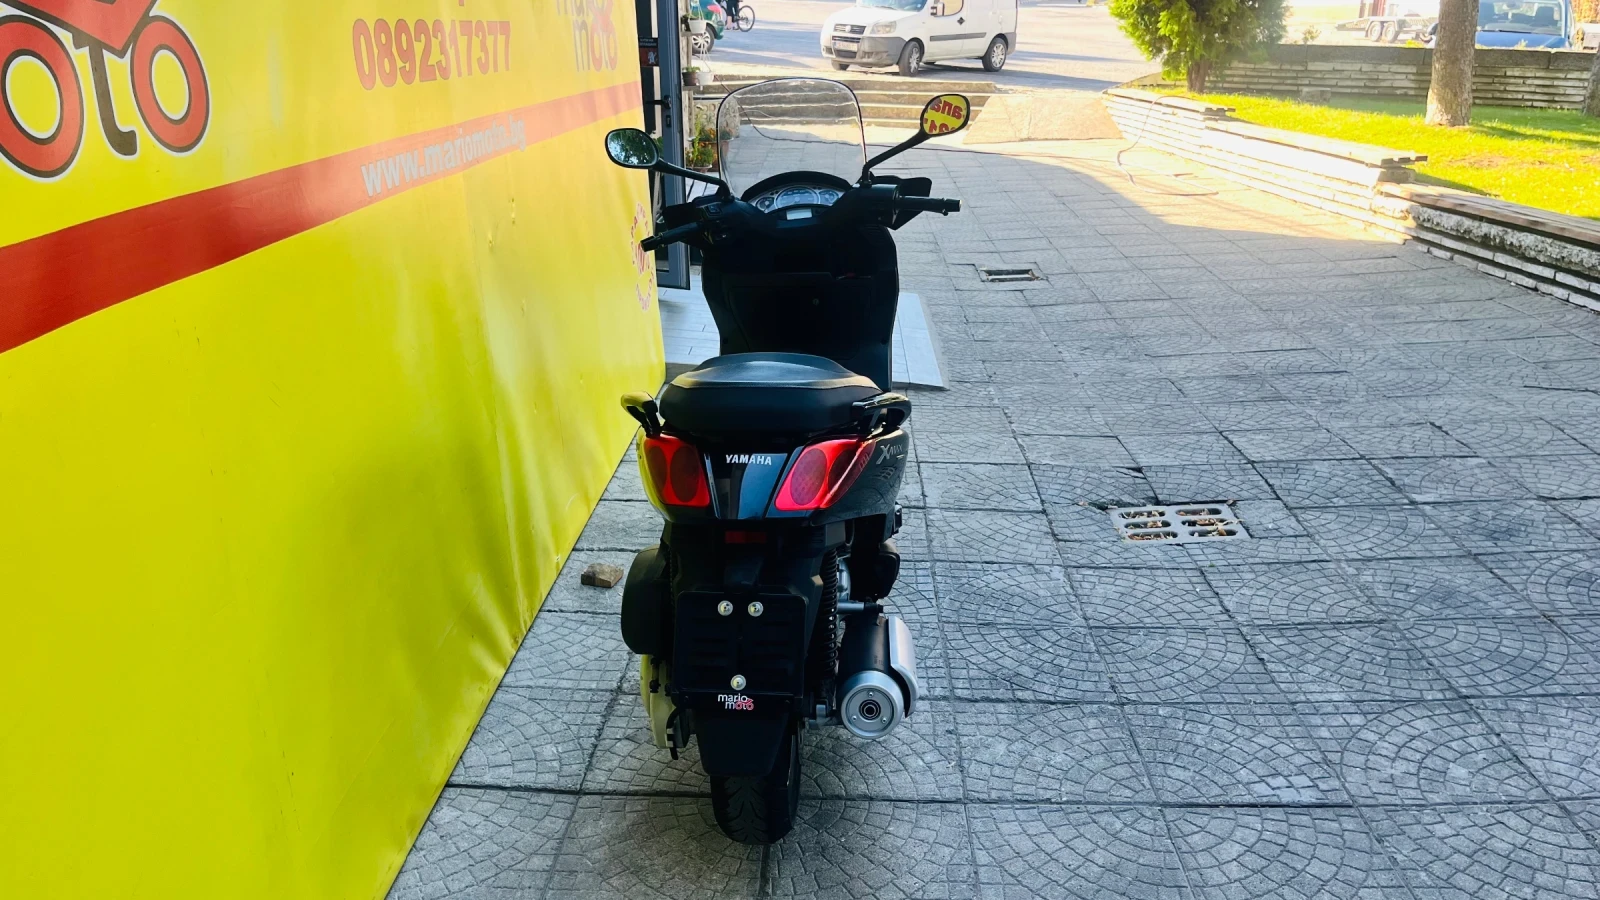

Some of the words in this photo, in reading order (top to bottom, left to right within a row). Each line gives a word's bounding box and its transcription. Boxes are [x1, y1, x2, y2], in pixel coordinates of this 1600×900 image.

[352, 18, 511, 91] 0892317377
[361, 114, 527, 197] www.mariomoto.bg
[725, 454, 772, 466] YAMAHA
[717, 692, 749, 703] mario
[725, 700, 754, 711] moto
